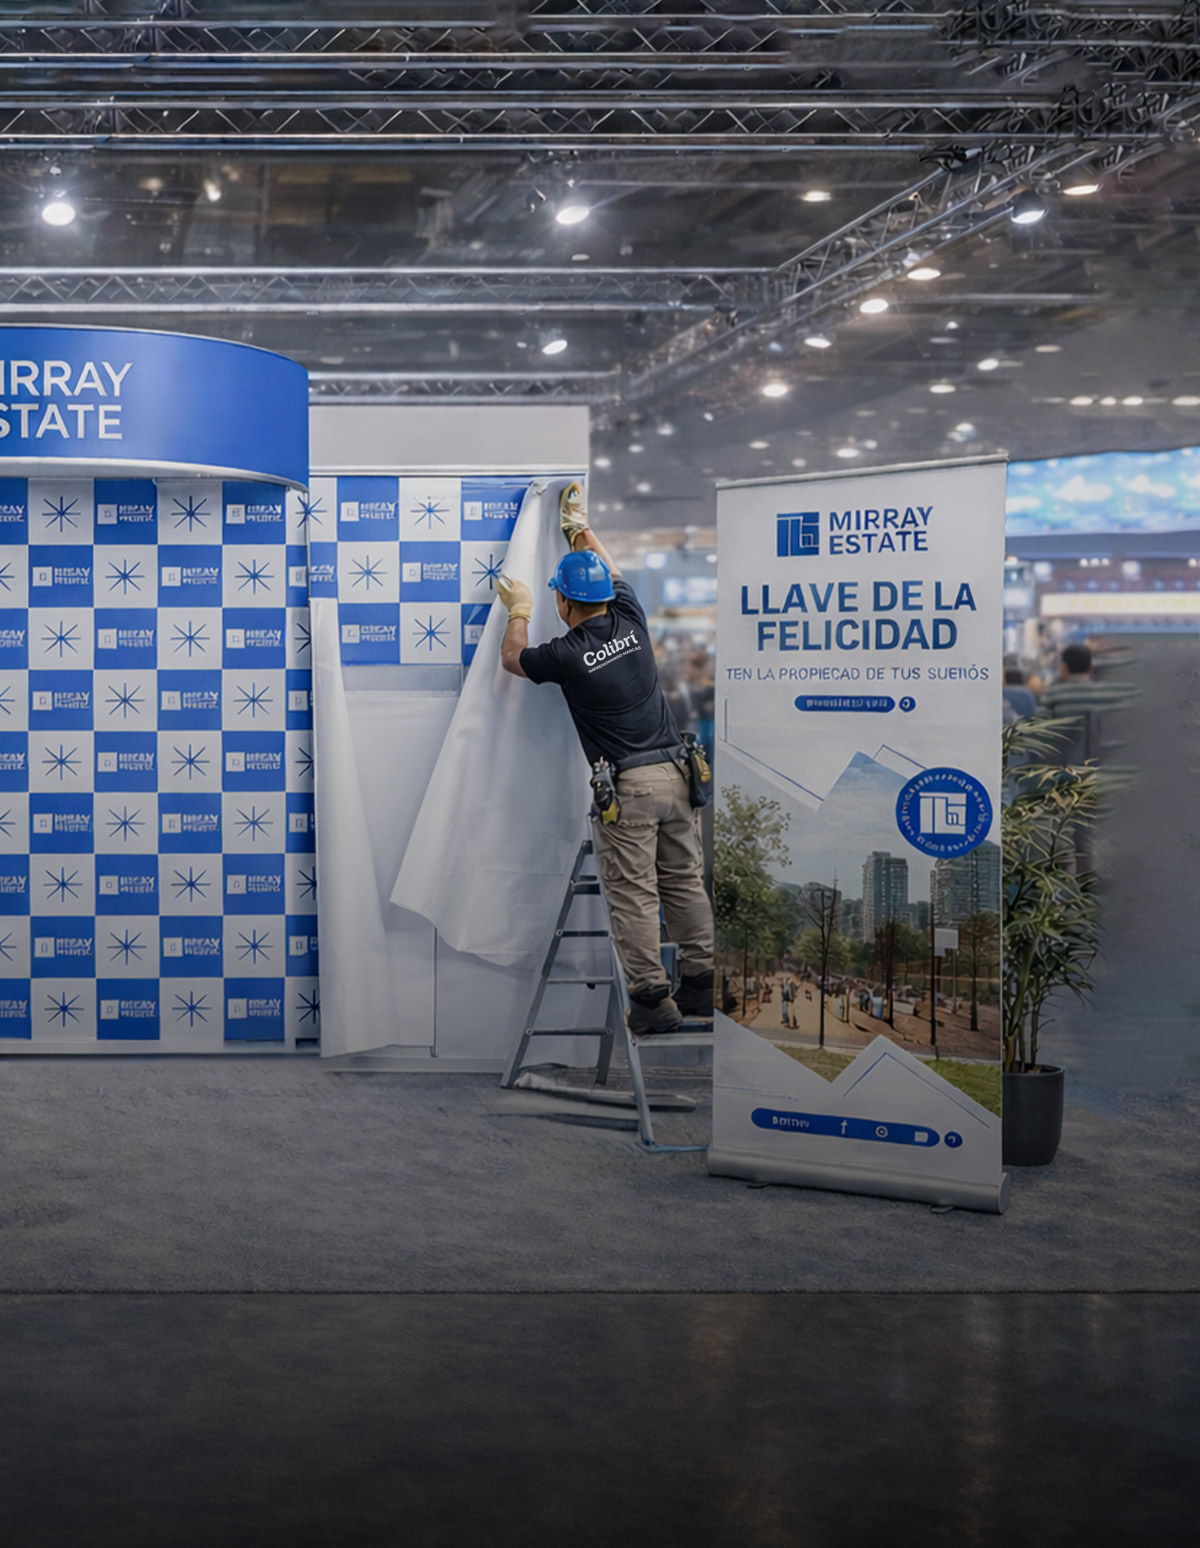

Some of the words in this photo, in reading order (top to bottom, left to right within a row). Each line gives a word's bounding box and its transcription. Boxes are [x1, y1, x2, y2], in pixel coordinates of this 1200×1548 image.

[829, 506, 934, 532] MIRRAY
[829, 530, 929, 555] ESTATE
[741, 581, 860, 615] LLAVE
[873, 580, 924, 612] DE
[934, 581, 977, 611] LA
[583, 630, 639, 667] Colibrí
[757, 618, 958, 651] FELICIDAD
[726, 667, 753, 681] TEN
[757, 667, 776, 681] LA
[866, 667, 885, 681] DE
[891, 667, 922, 681] TUS
